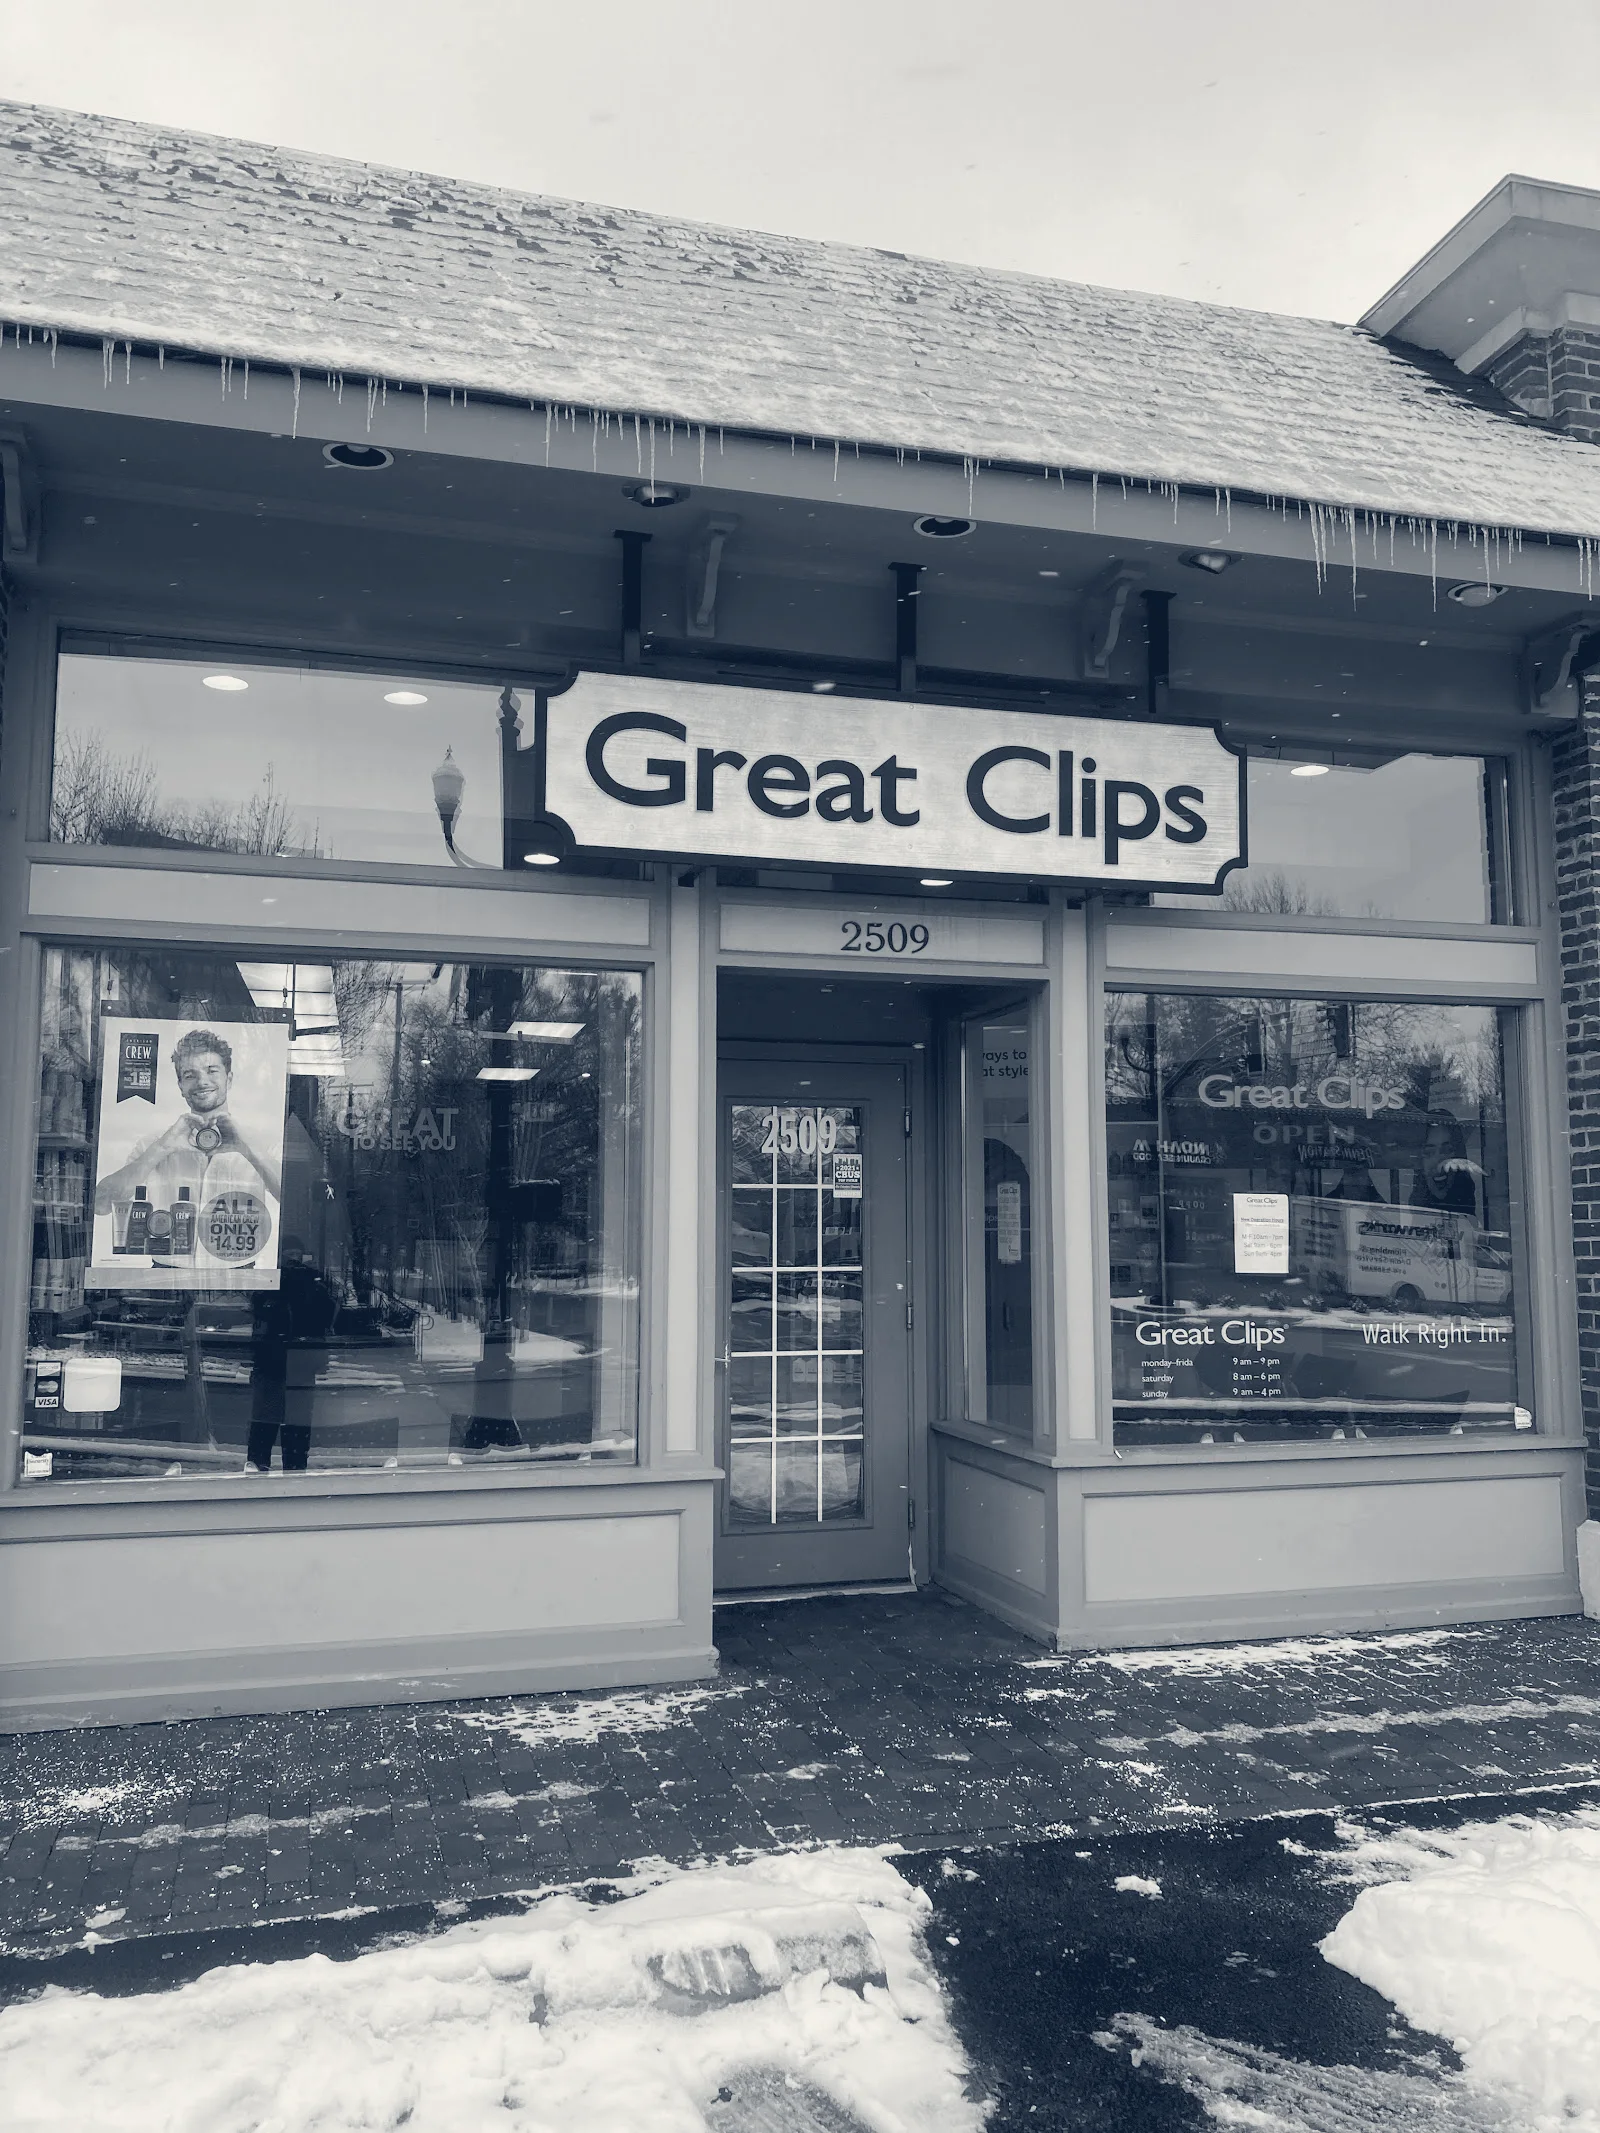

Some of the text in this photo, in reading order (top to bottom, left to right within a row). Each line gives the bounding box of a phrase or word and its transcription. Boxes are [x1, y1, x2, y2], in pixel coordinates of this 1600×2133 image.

[585, 710, 1208, 865] Great Clips
[840, 921, 930, 954] 2509
[125, 1045, 152, 1059] CREW
[1012, 1049, 1027, 1060] to
[1199, 1074, 1309, 1109] Great
[1318, 1076, 1406, 1119] Clips
[336, 1107, 459, 1137] GREAT
[761, 1115, 837, 1154] 2509
[1253, 1124, 1355, 1144] OPEN
[350, 1136, 457, 1151] TO SEE YOU
[835, 1171, 861, 1179] CBUS
[211, 1199, 260, 1214] ALL
[132, 1210, 147, 1219] CREW
[175, 1211, 190, 1220] CREW
[210, 1224, 259, 1235] ONLY
[210, 1235, 256, 1251] $14.99
[1135, 1320, 1286, 1351] Great Clips
[1362, 1322, 1507, 1349] Walk Right In.
[1232, 1357, 1238, 1365] 9
[1260, 1357, 1266, 1365] 9
[1267, 1358, 1280, 1367] pm
[1141, 1374, 1174, 1383] saturday
[1232, 1372, 1238, 1381] 8
[1260, 1372, 1266, 1380] 6
[1268, 1374, 1281, 1382] pm
[1142, 1389, 1169, 1399] sunday
[1232, 1388, 1238, 1396] 9
[1261, 1388, 1267, 1396] 4
[1268, 1388, 1281, 1397] pm
[37, 1398, 57, 1406] VISA
